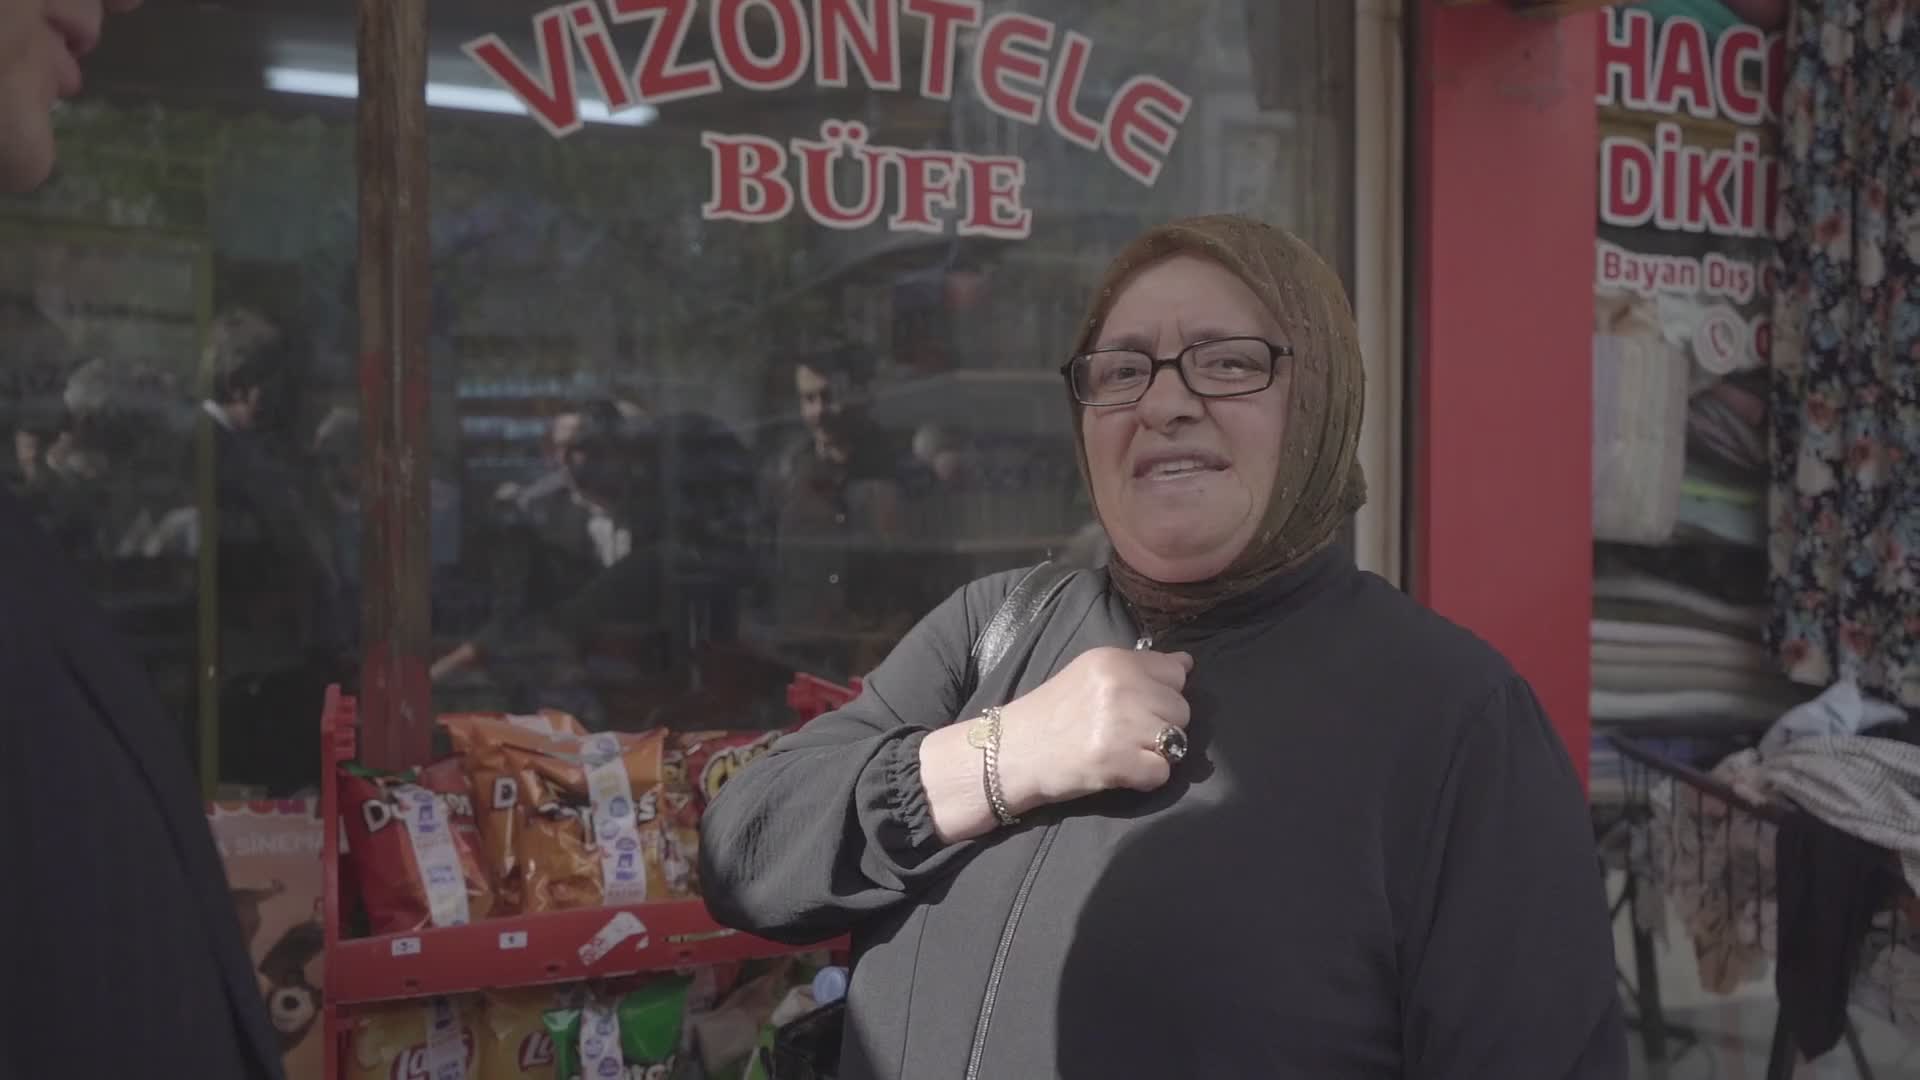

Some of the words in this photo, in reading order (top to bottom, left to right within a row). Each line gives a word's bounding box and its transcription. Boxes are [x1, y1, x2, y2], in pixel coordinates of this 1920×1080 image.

[702, 121, 1032, 238] BÜFE
[1602, 248, 1698, 293] Bayan
[1706, 257, 1752, 300] Dış
